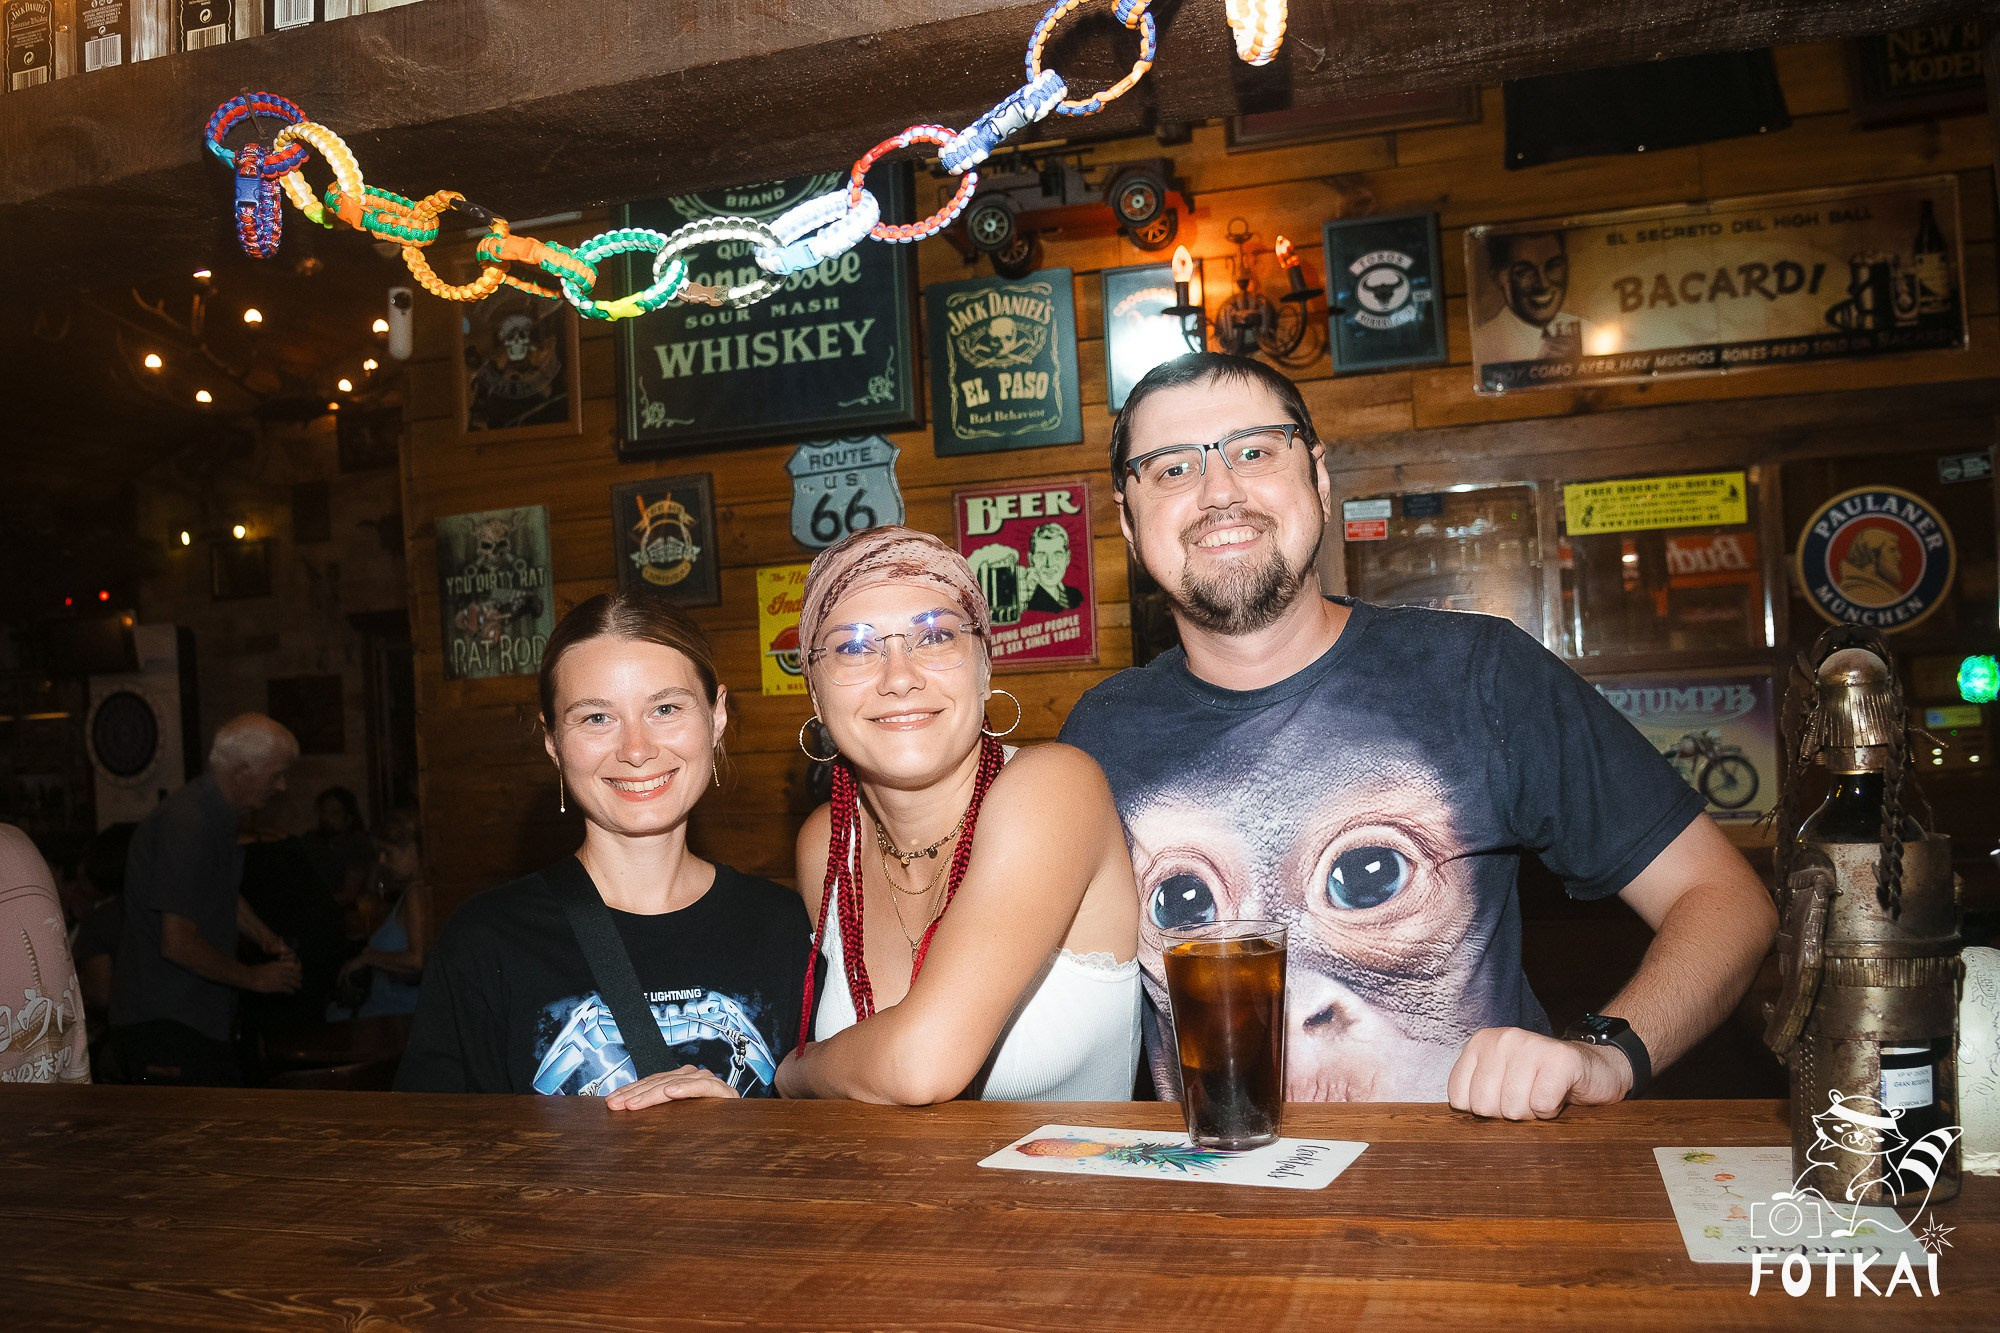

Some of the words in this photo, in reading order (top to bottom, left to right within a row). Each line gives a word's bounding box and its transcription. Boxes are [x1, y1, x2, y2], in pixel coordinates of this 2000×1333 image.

[726, 187, 785, 208] BRAND
[1606, 233, 1628, 246] EL
[1636, 222, 1723, 243] SECRETO
[1731, 219, 1766, 234] DEL
[1773, 212, 1819, 229] HIGH
[1828, 207, 1872, 225] BALL
[1612, 260, 1826, 314] BACARDI
[685, 309, 751, 329] SOUR
[770, 297, 840, 318] MASH
[947, 300, 989, 335] JACK
[653, 318, 875, 380] WHISKEY
[1529, 363, 1573, 378] COMO
[1654, 350, 1715, 368] MUCHOS
[960, 377, 991, 408] EL
[998, 371, 1049, 400] PASO
[809, 447, 872, 470] ROUTE
[811, 489, 876, 543] 66
[966, 490, 1081, 535] BEER
[1813, 495, 1944, 551] PAULANER
[446, 575, 472, 595] YOU
[476, 570, 513, 592] DIRTY
[520, 568, 545, 587] RAT
[789, 570, 806, 584] Ne
[1044, 614, 1080, 632] PEOPLE
[454, 638, 492, 675] RAT
[500, 634, 547, 674] ROD
[1006, 640, 1024, 654] SEX
[1025, 634, 1051, 650] SINCE
[1597, 684, 1757, 713] RIUMPH
[650, 988, 702, 1003] LIGHTNING
